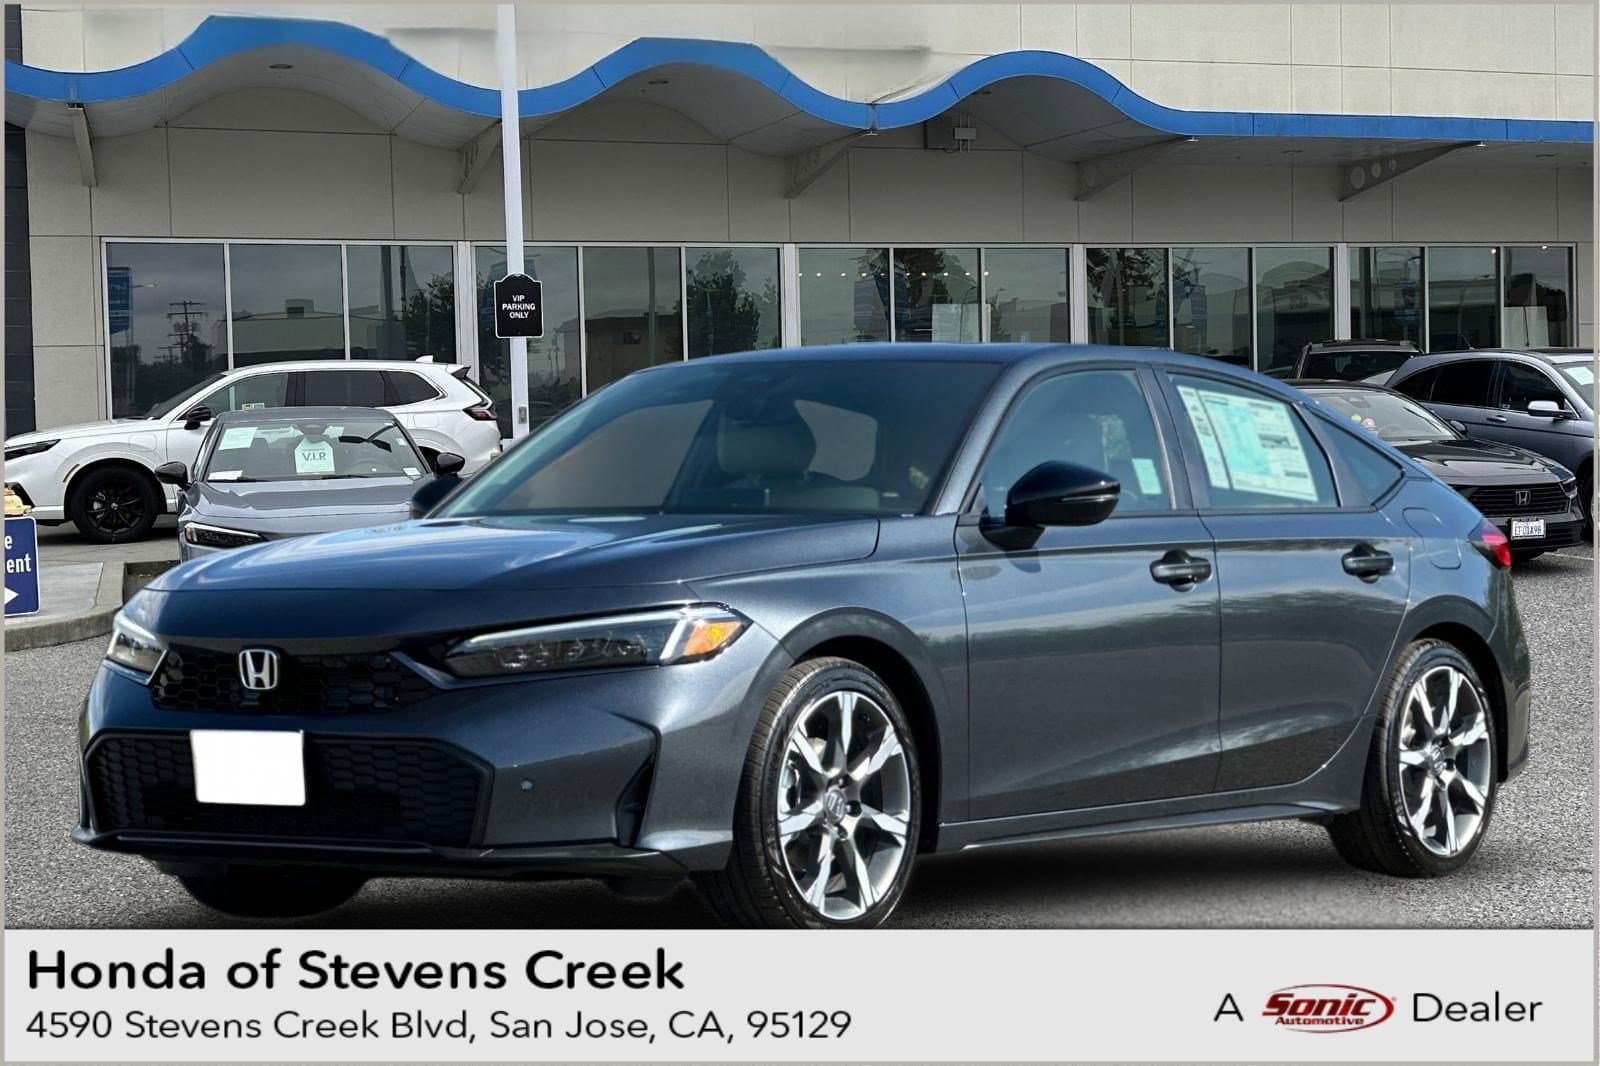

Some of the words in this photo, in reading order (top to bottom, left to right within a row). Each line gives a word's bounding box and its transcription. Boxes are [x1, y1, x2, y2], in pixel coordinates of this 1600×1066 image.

[512, 294, 525, 302] VIP
[502, 303, 536, 311] PARKING
[509, 311, 529, 319] ONLY
